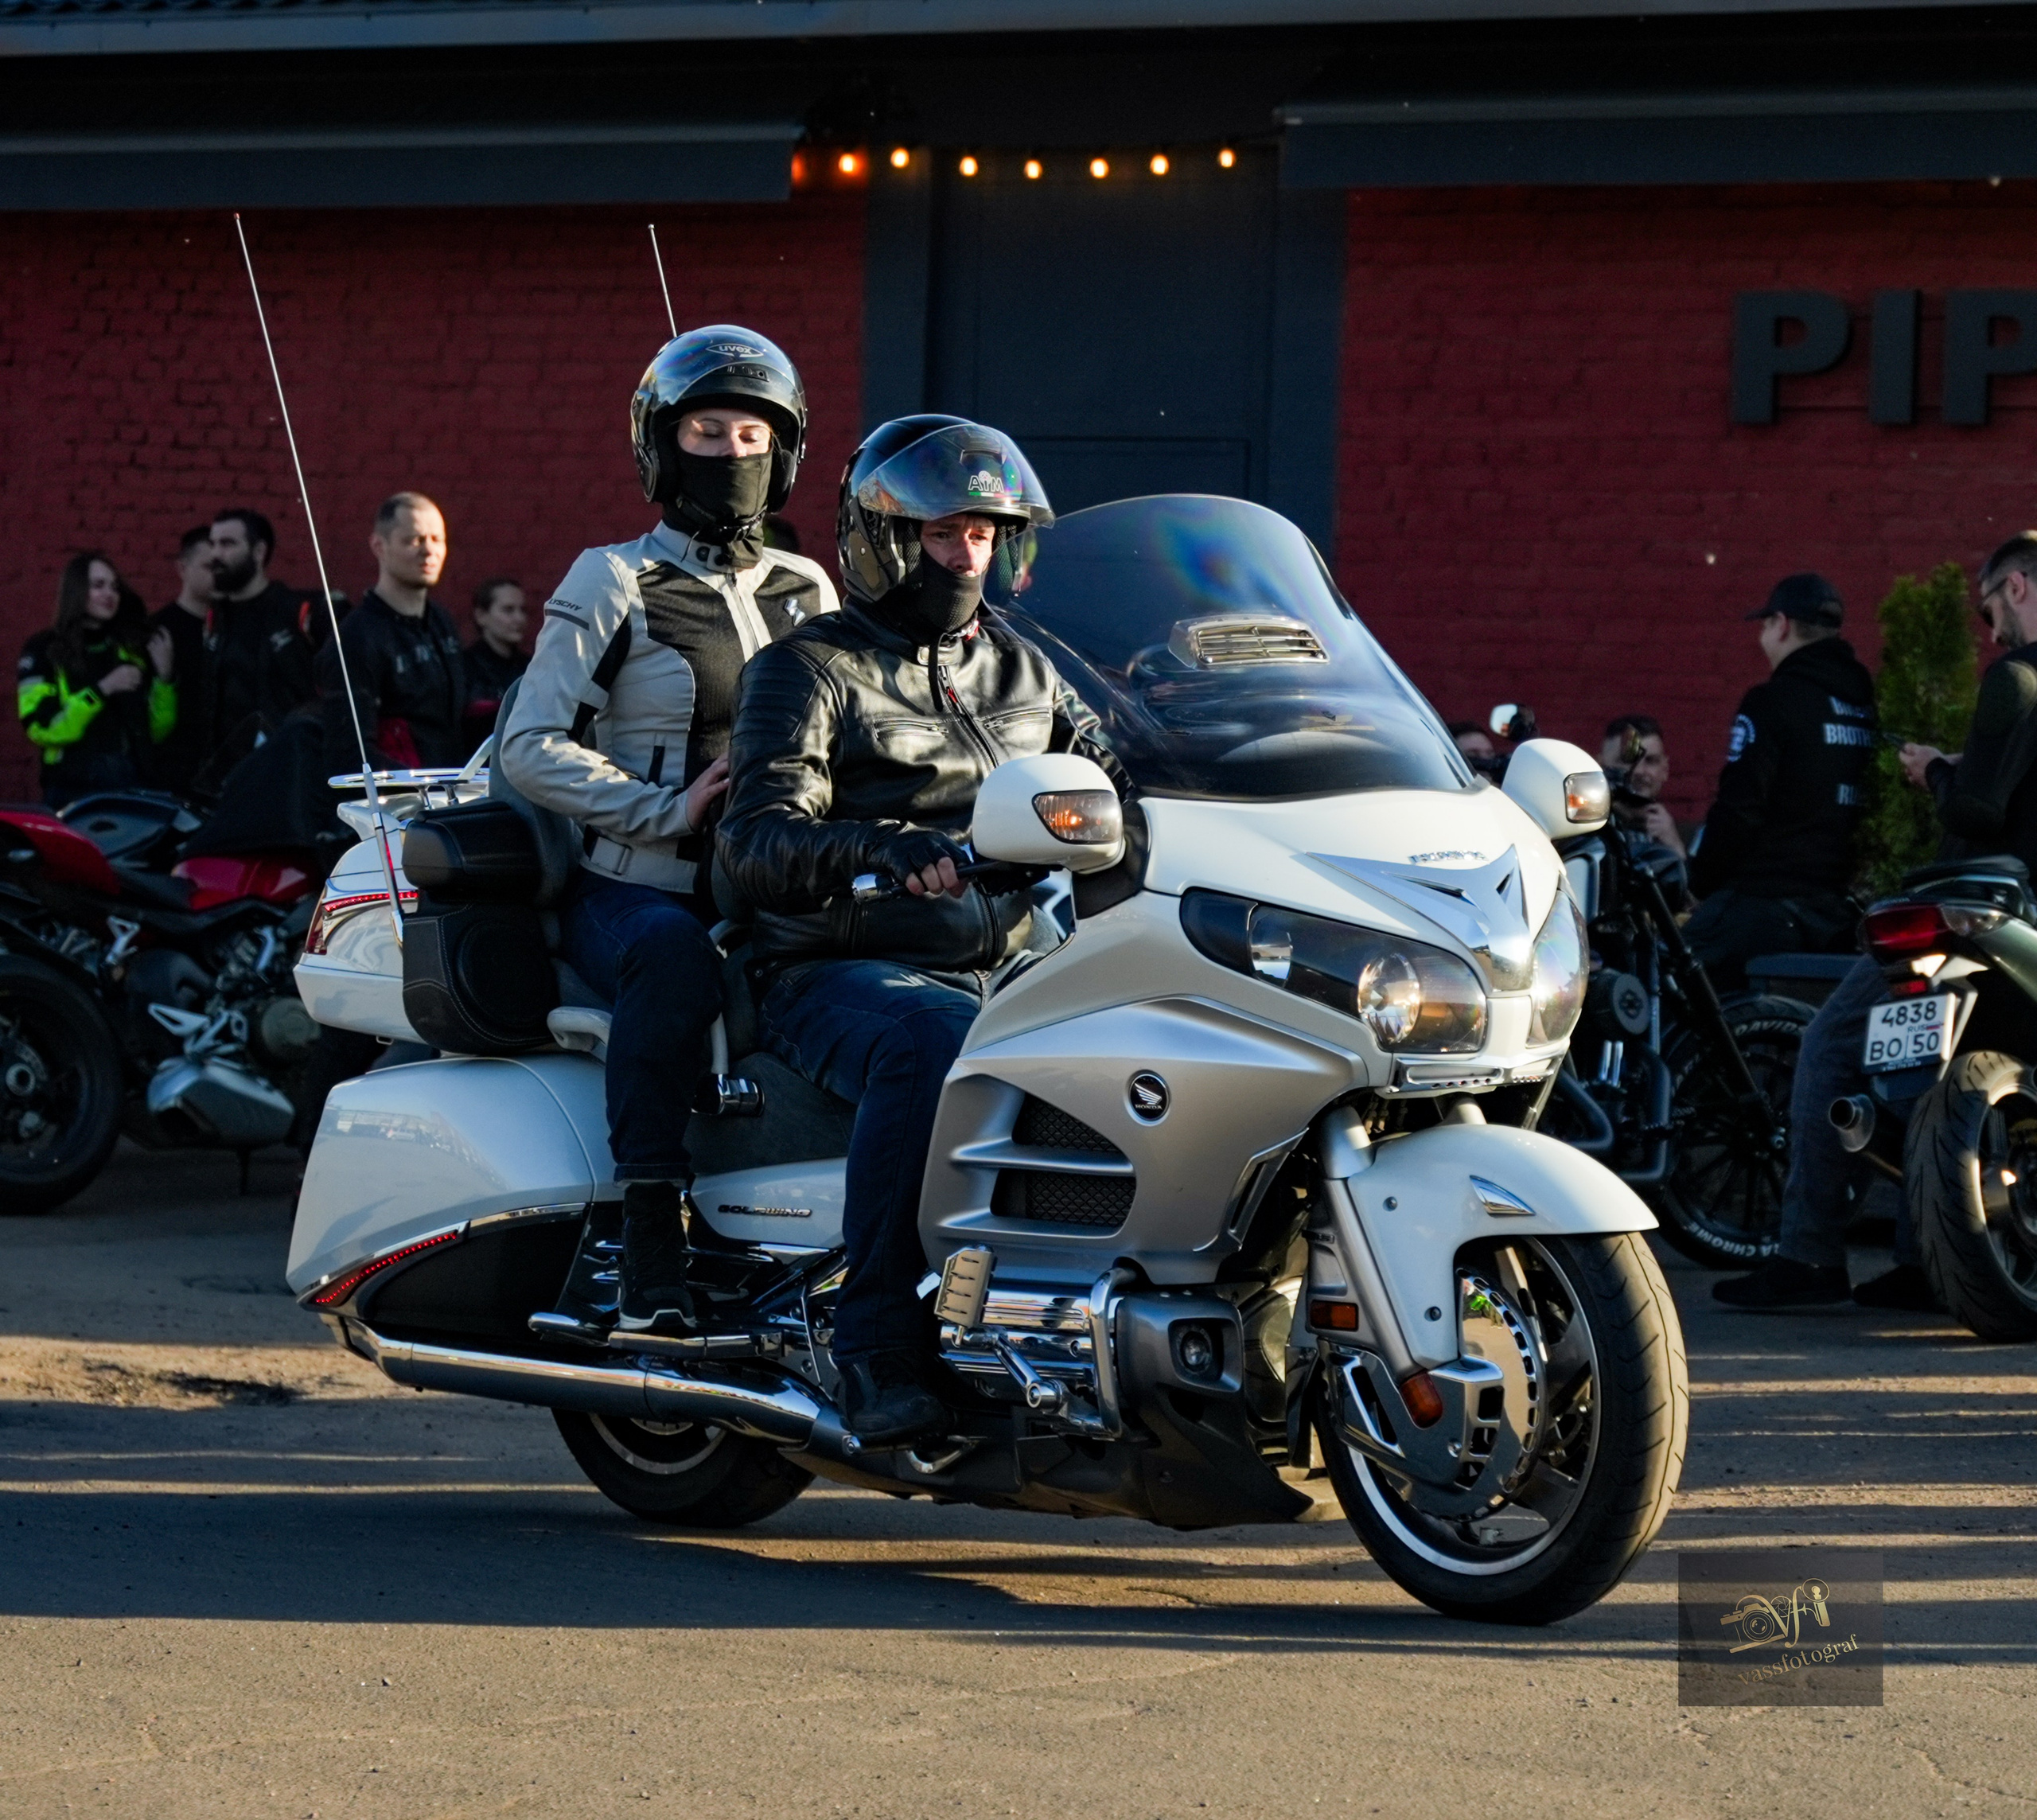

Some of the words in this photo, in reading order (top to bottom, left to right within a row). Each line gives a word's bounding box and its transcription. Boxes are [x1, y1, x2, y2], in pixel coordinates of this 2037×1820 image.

[719, 345, 753, 354] uvex
[1882, 1001, 1937, 1027] 4838
[1907, 1023, 1927, 1033] RUS
[1912, 1032, 1940, 1054] 50
